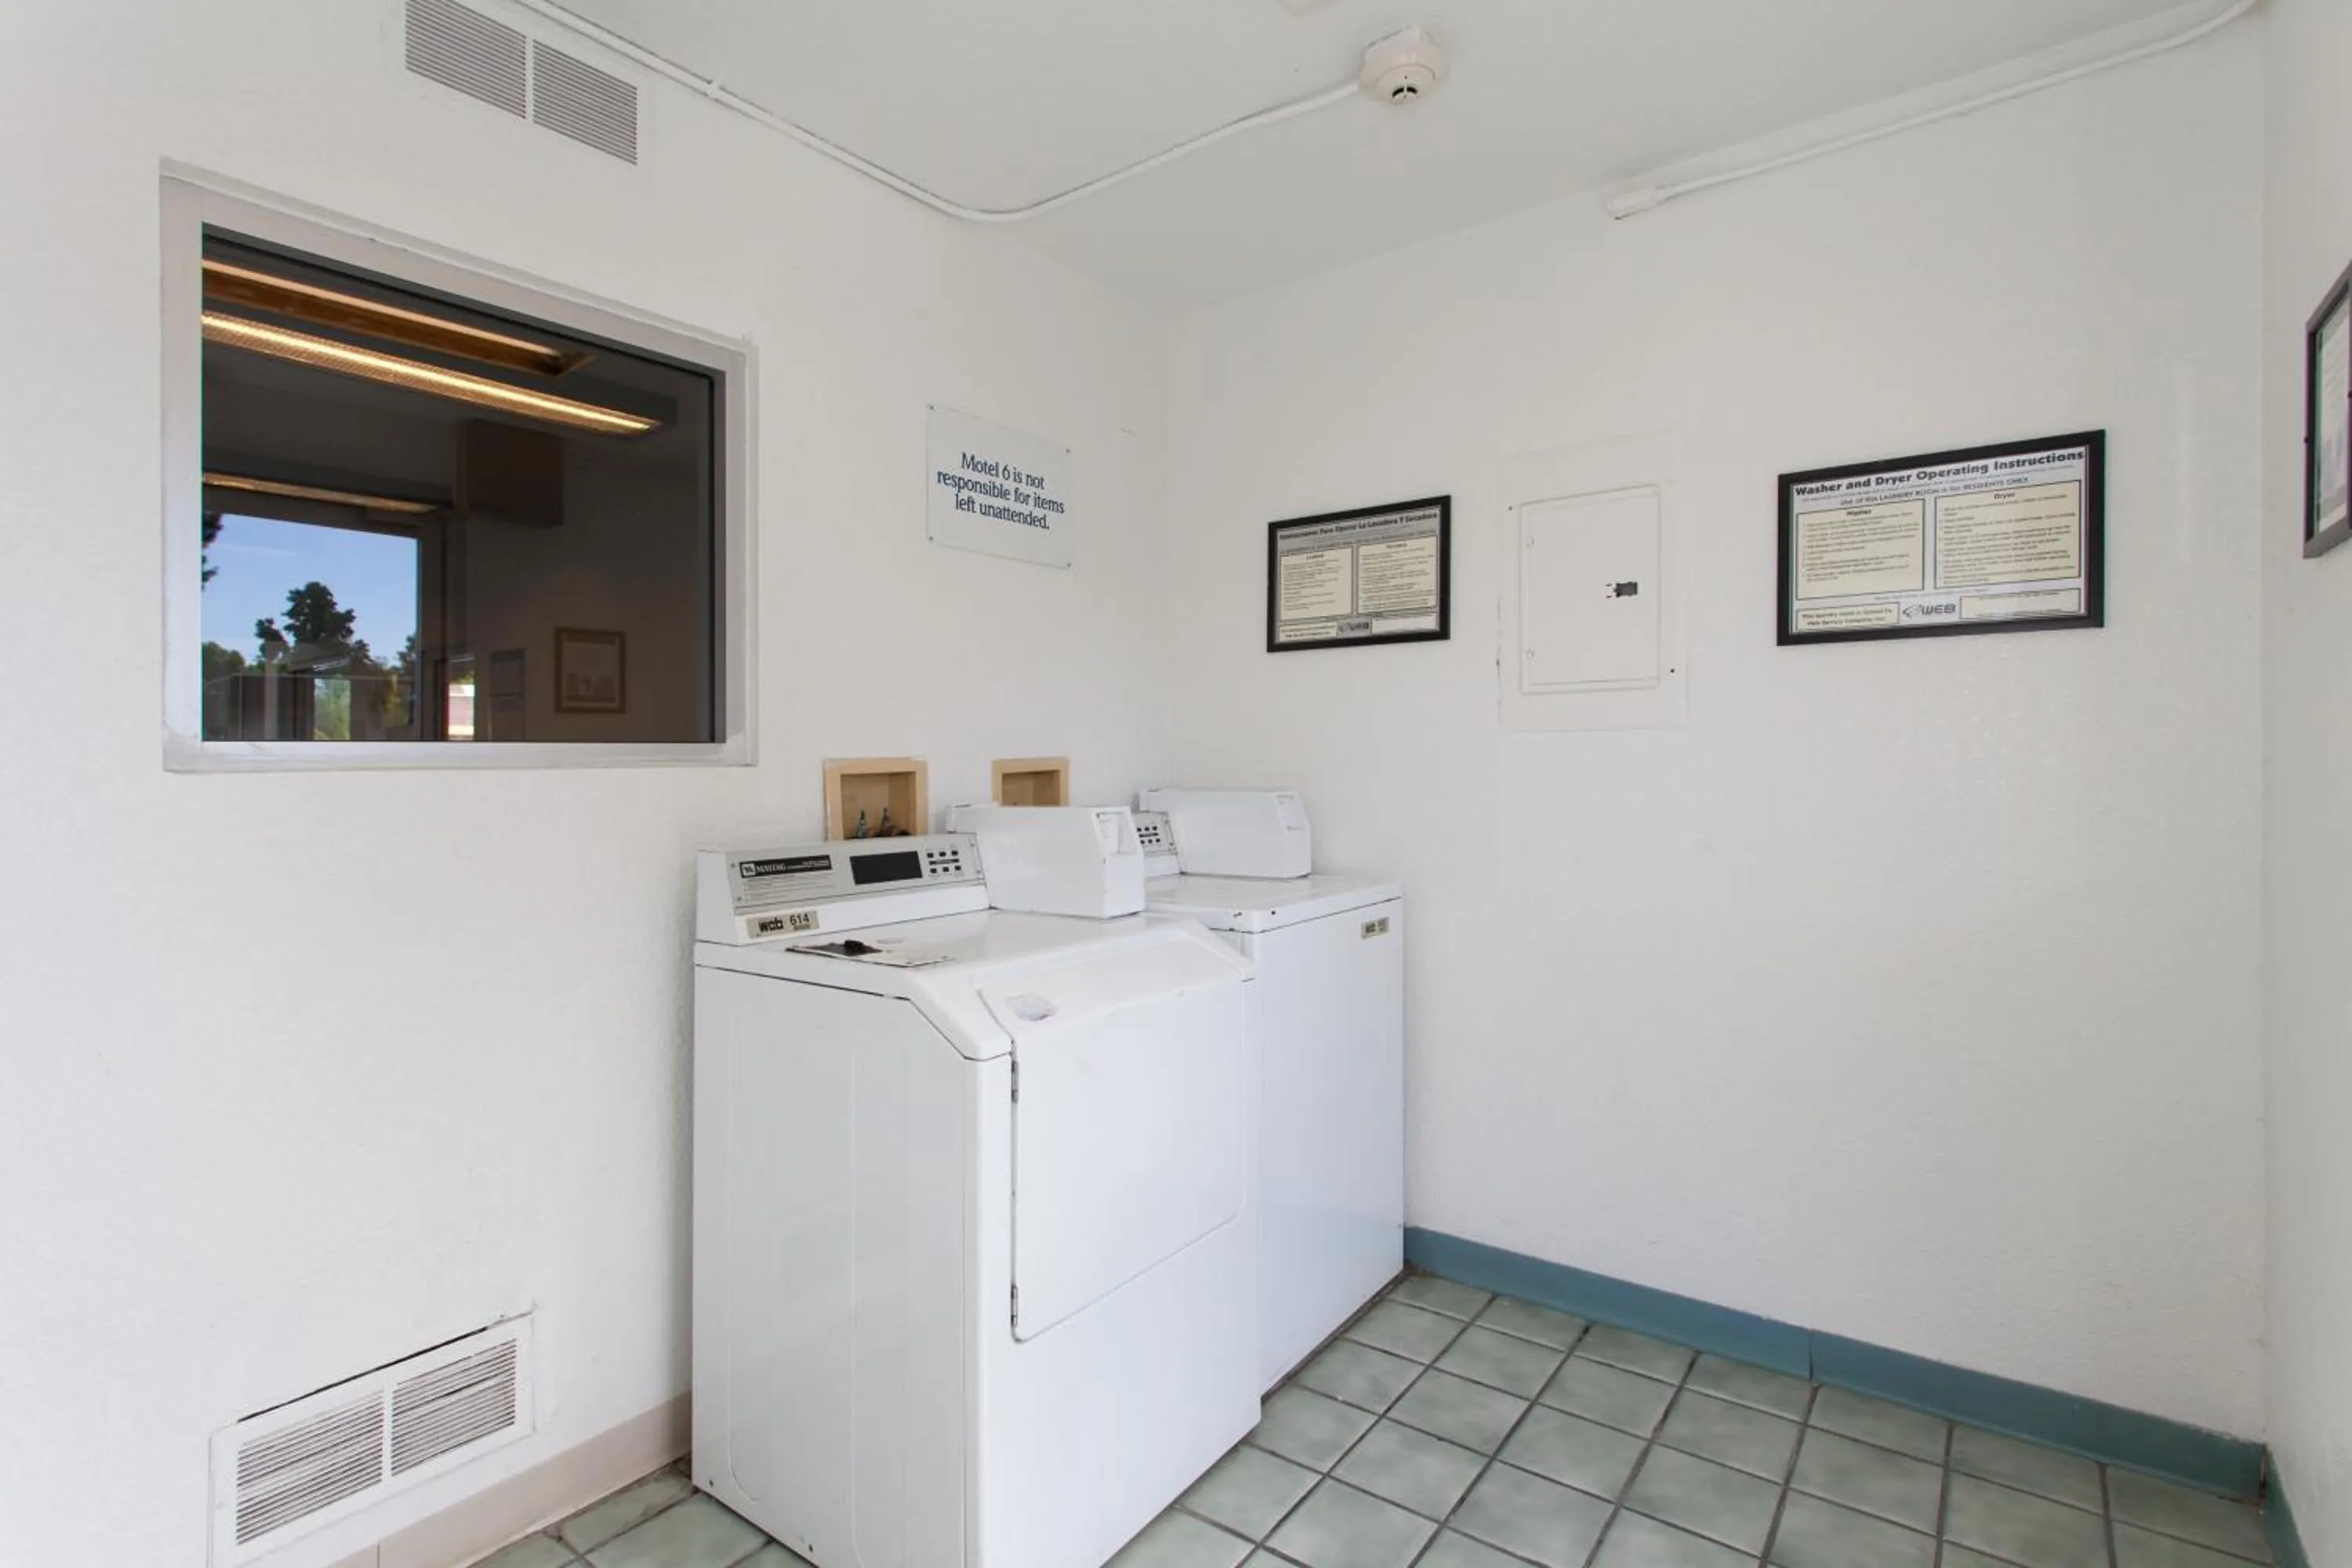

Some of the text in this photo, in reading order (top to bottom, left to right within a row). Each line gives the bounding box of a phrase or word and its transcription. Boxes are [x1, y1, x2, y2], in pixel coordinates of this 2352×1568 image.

[961, 452, 1045, 490] Motel 6 is not
[1795, 482, 1842, 495] Washer
[1846, 477, 1871, 490] and
[1875, 474, 1912, 485] Dryer
[1915, 463, 1989, 480] Operating
[1994, 450, 2085, 470] Instructions
[937, 470, 1065, 514] responsible for items
[955, 494, 1050, 530] left unattended.
[789, 913, 810, 926] 614
